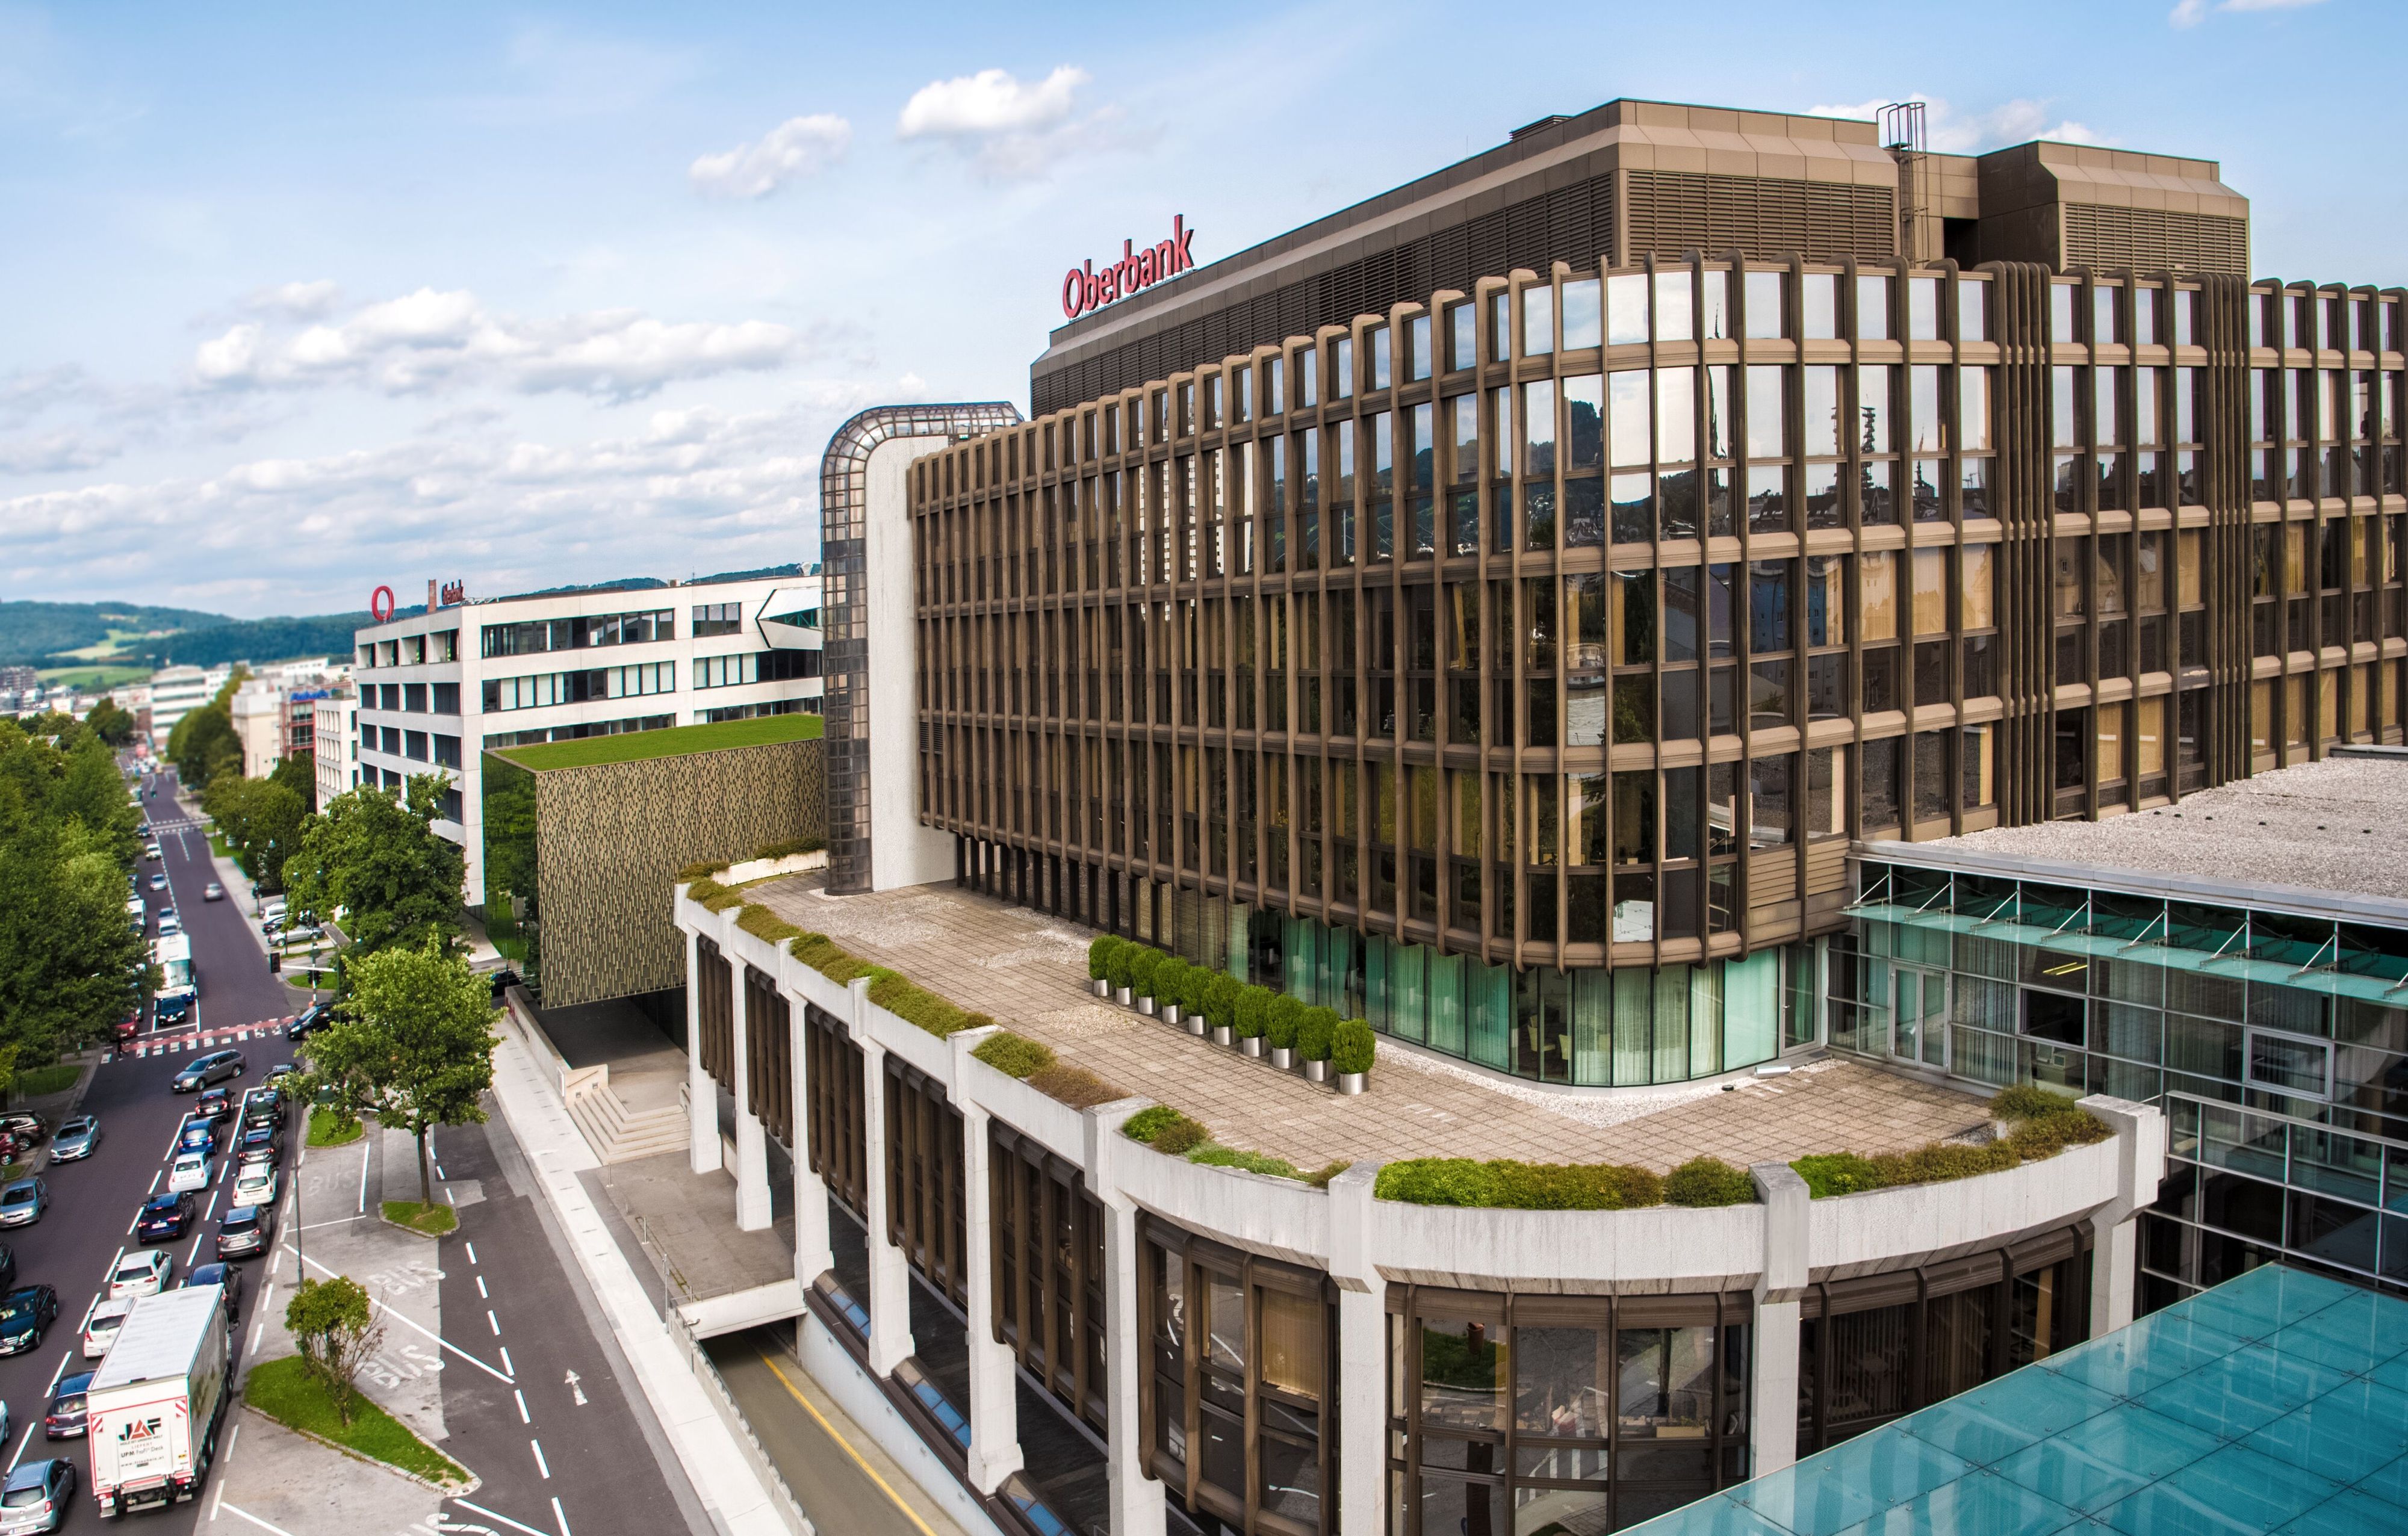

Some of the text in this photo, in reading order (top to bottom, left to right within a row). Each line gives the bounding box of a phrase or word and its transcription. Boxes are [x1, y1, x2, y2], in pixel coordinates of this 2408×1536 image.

[1063, 214, 1194, 318] Oberbank
[367, 1260, 446, 1295] BUS
[355, 1345, 445, 1389] BUS
[118, 1417, 161, 1441] JAF
